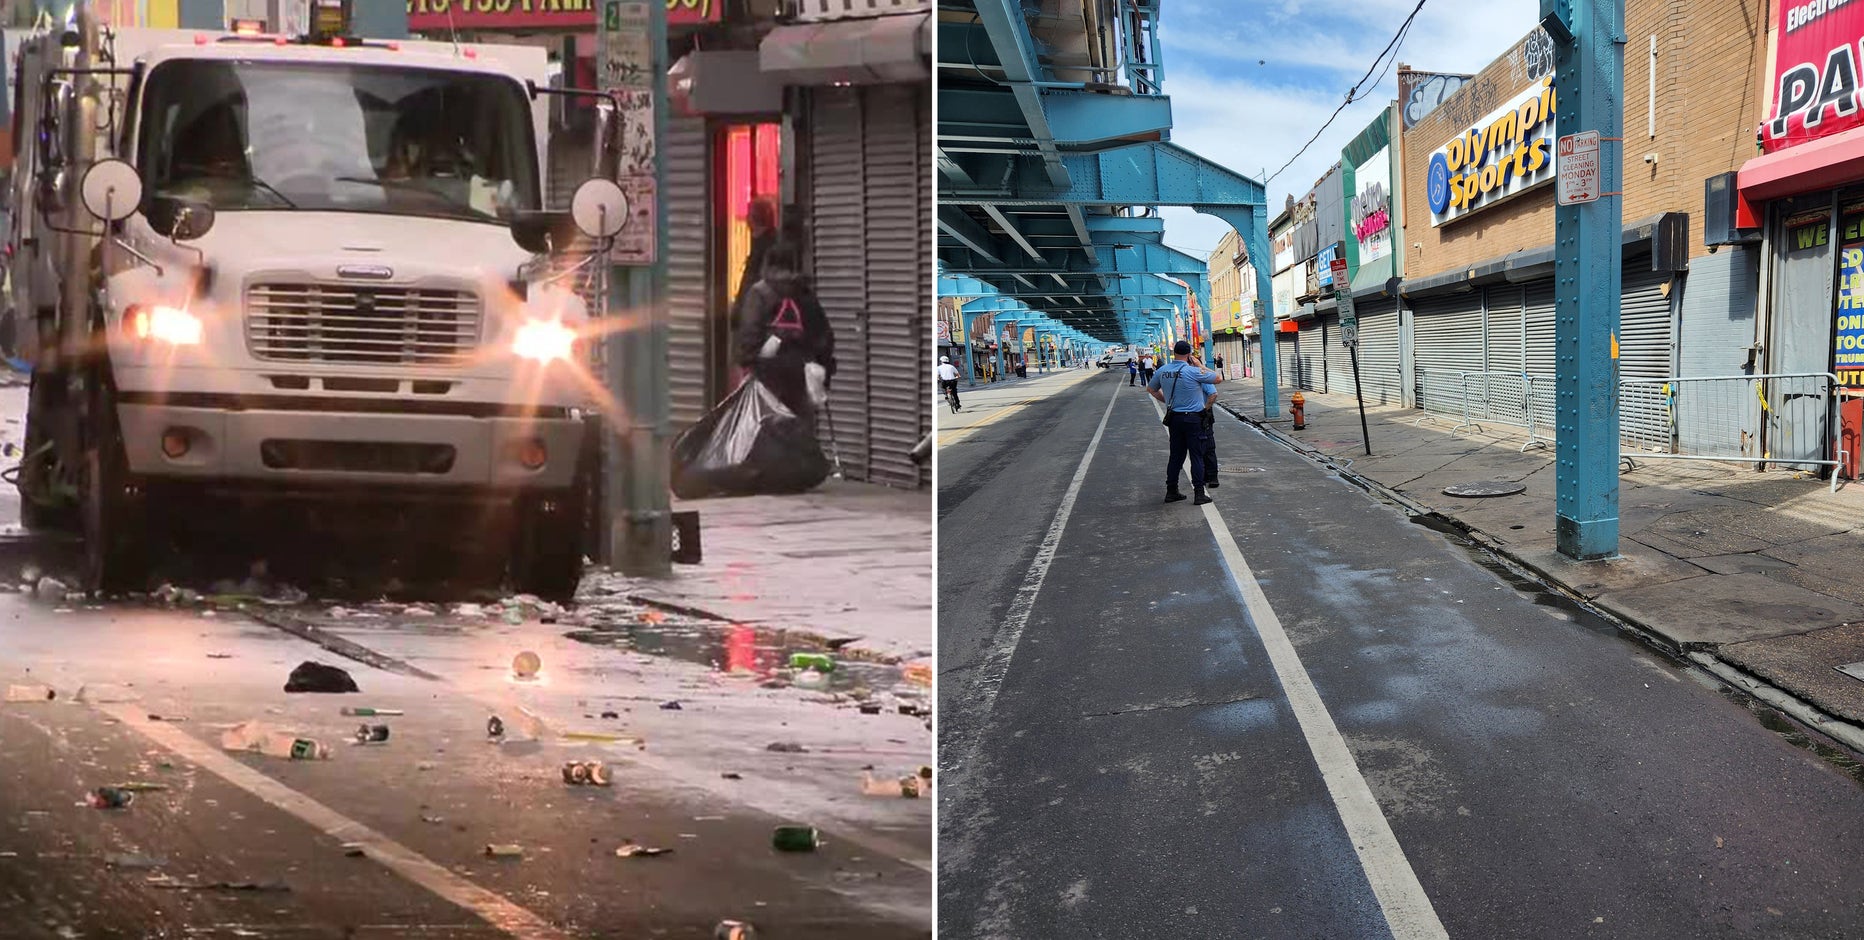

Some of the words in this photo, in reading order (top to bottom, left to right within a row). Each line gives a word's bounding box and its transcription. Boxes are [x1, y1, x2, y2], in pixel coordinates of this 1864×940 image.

[1770, 36, 1864, 139] PA
[1560, 139, 1572, 153] NO
[1575, 137, 1596, 149] PARKING
[1563, 160, 1594, 172] CLEANING
[1567, 153, 1589, 163] STREET
[1448, 138, 1551, 209] Sports
[1561, 168, 1597, 181] MONDAY
[1797, 223, 1827, 250] WE
